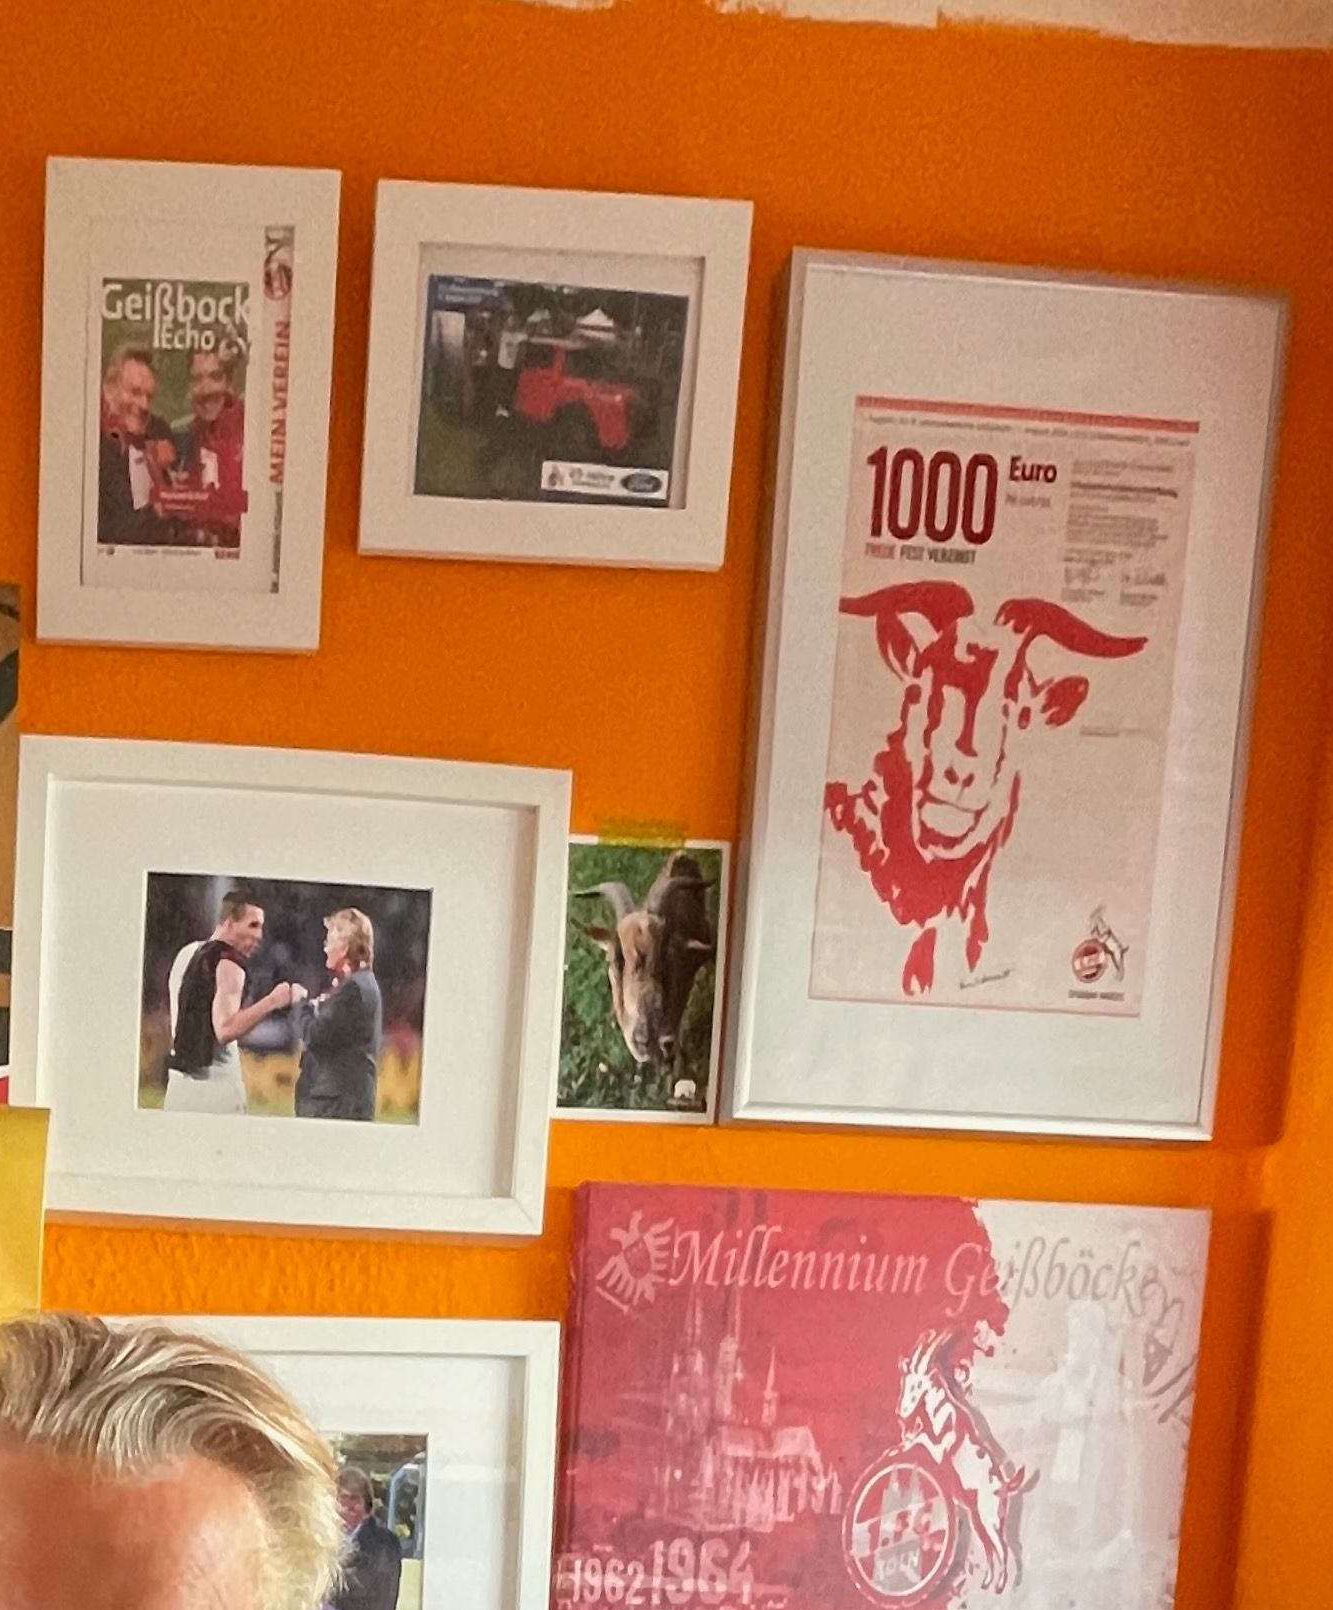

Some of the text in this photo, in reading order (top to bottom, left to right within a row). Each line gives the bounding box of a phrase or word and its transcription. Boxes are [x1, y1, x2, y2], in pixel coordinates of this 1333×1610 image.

[101, 281, 250, 348] Geißbock
[161, 320, 215, 351] Echo
[271, 320, 292, 411] VEREIN
[269, 417, 288, 485] MEIN
[867, 446, 998, 545] 1000
[1009, 456, 1057, 483] Euro
[668, 1225, 928, 1295] Millennium
[572, 1537, 755, 1606] 1962 1964
